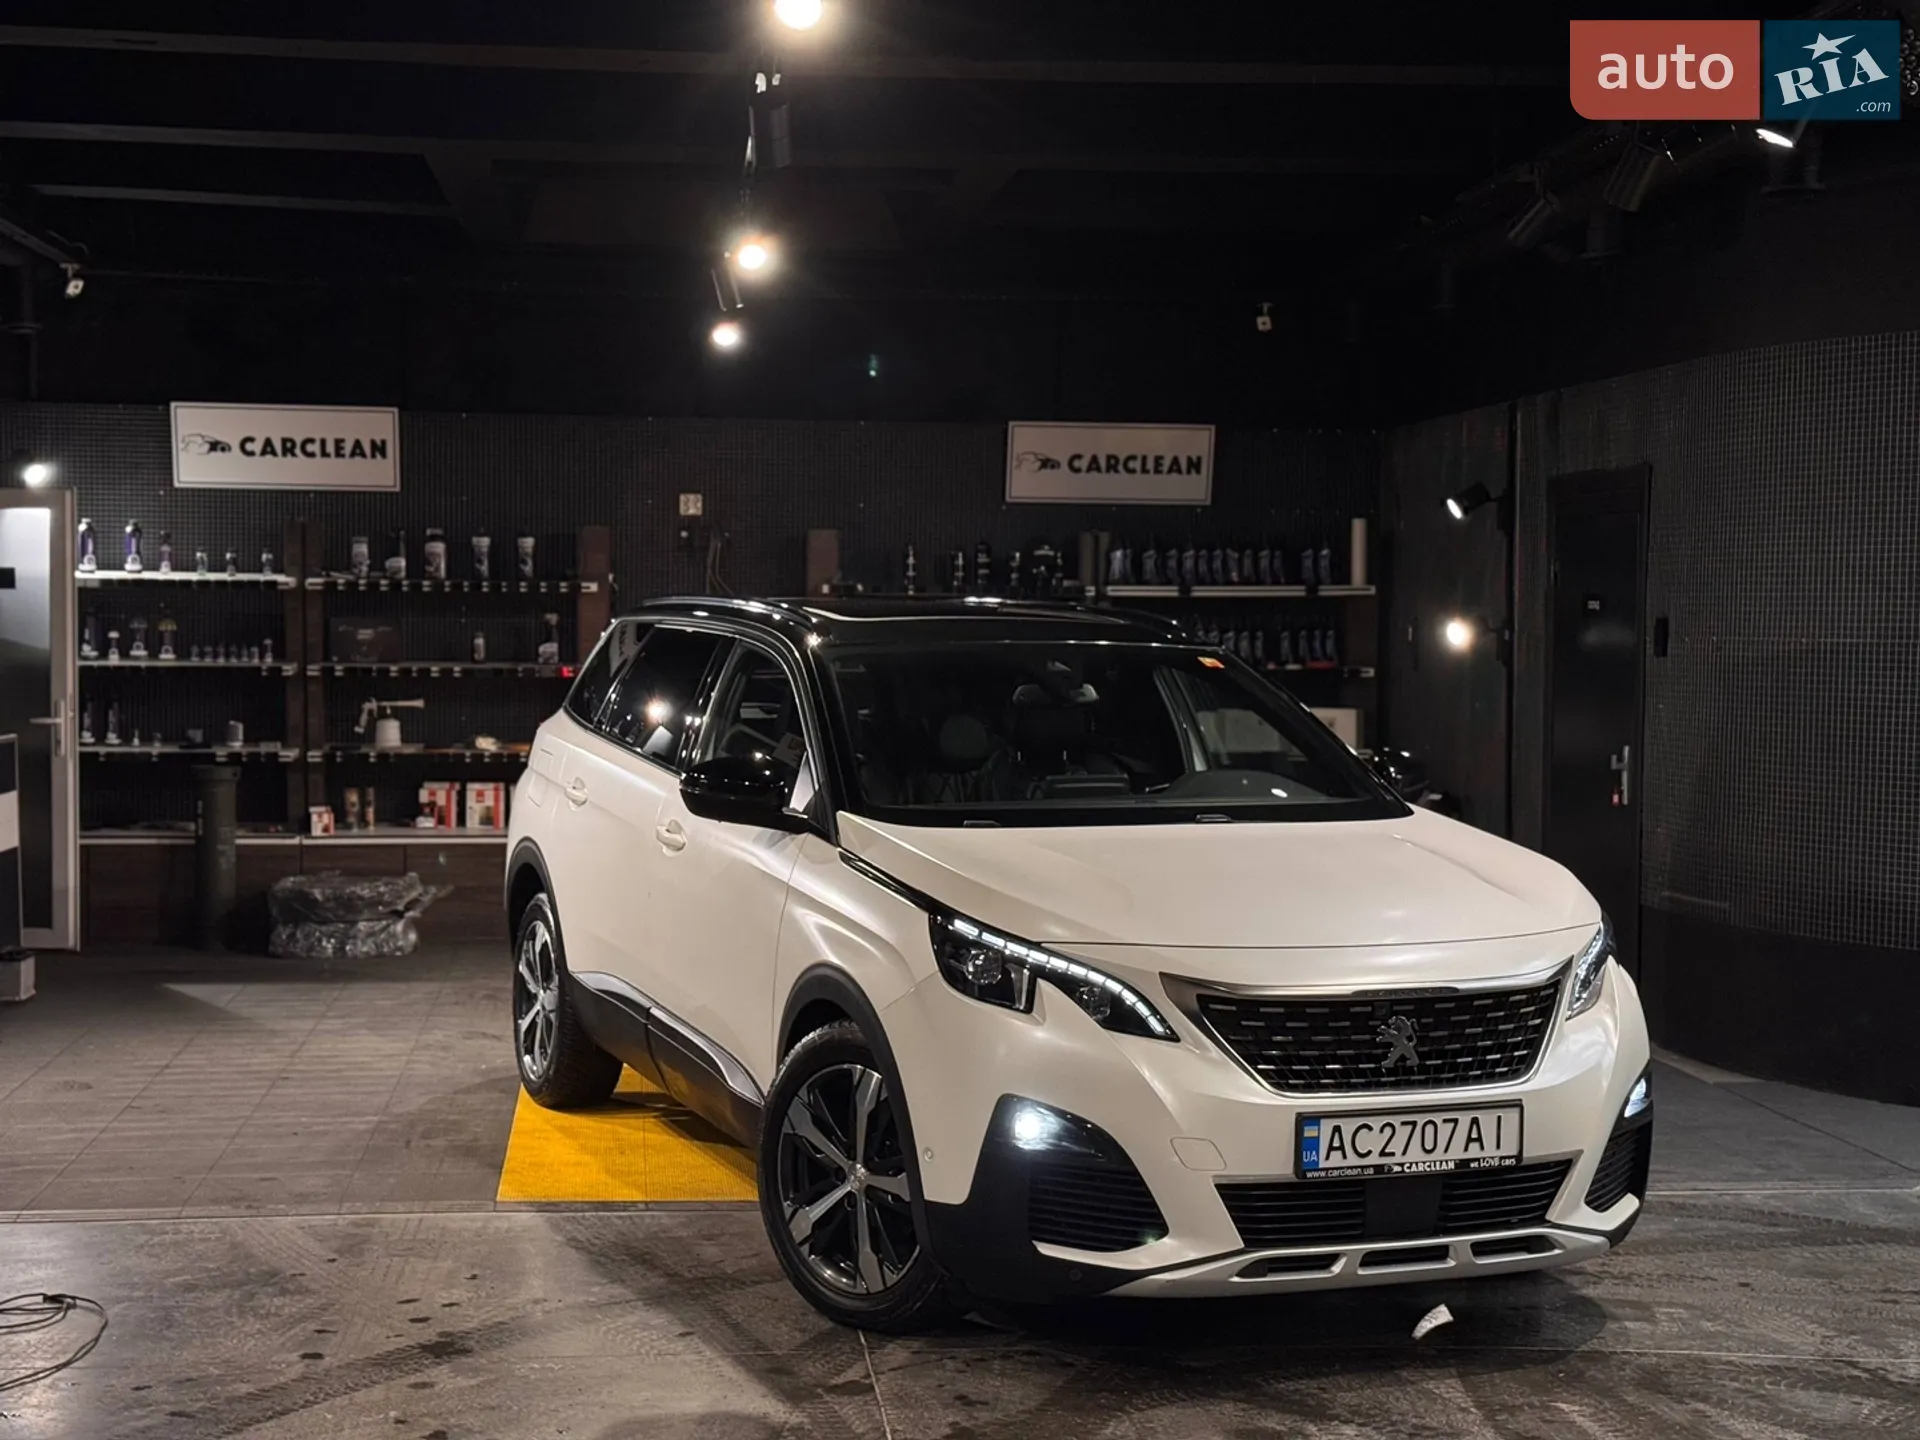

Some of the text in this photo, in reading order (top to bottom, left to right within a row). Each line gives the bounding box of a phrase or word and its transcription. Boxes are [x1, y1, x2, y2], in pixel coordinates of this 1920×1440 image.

[239, 436, 388, 459] CARCLEAN
[1067, 454, 1202, 475] CARCLEAN
[1303, 1150, 1318, 1163] UA
[1305, 1166, 1375, 1179] www.carclean.ua
